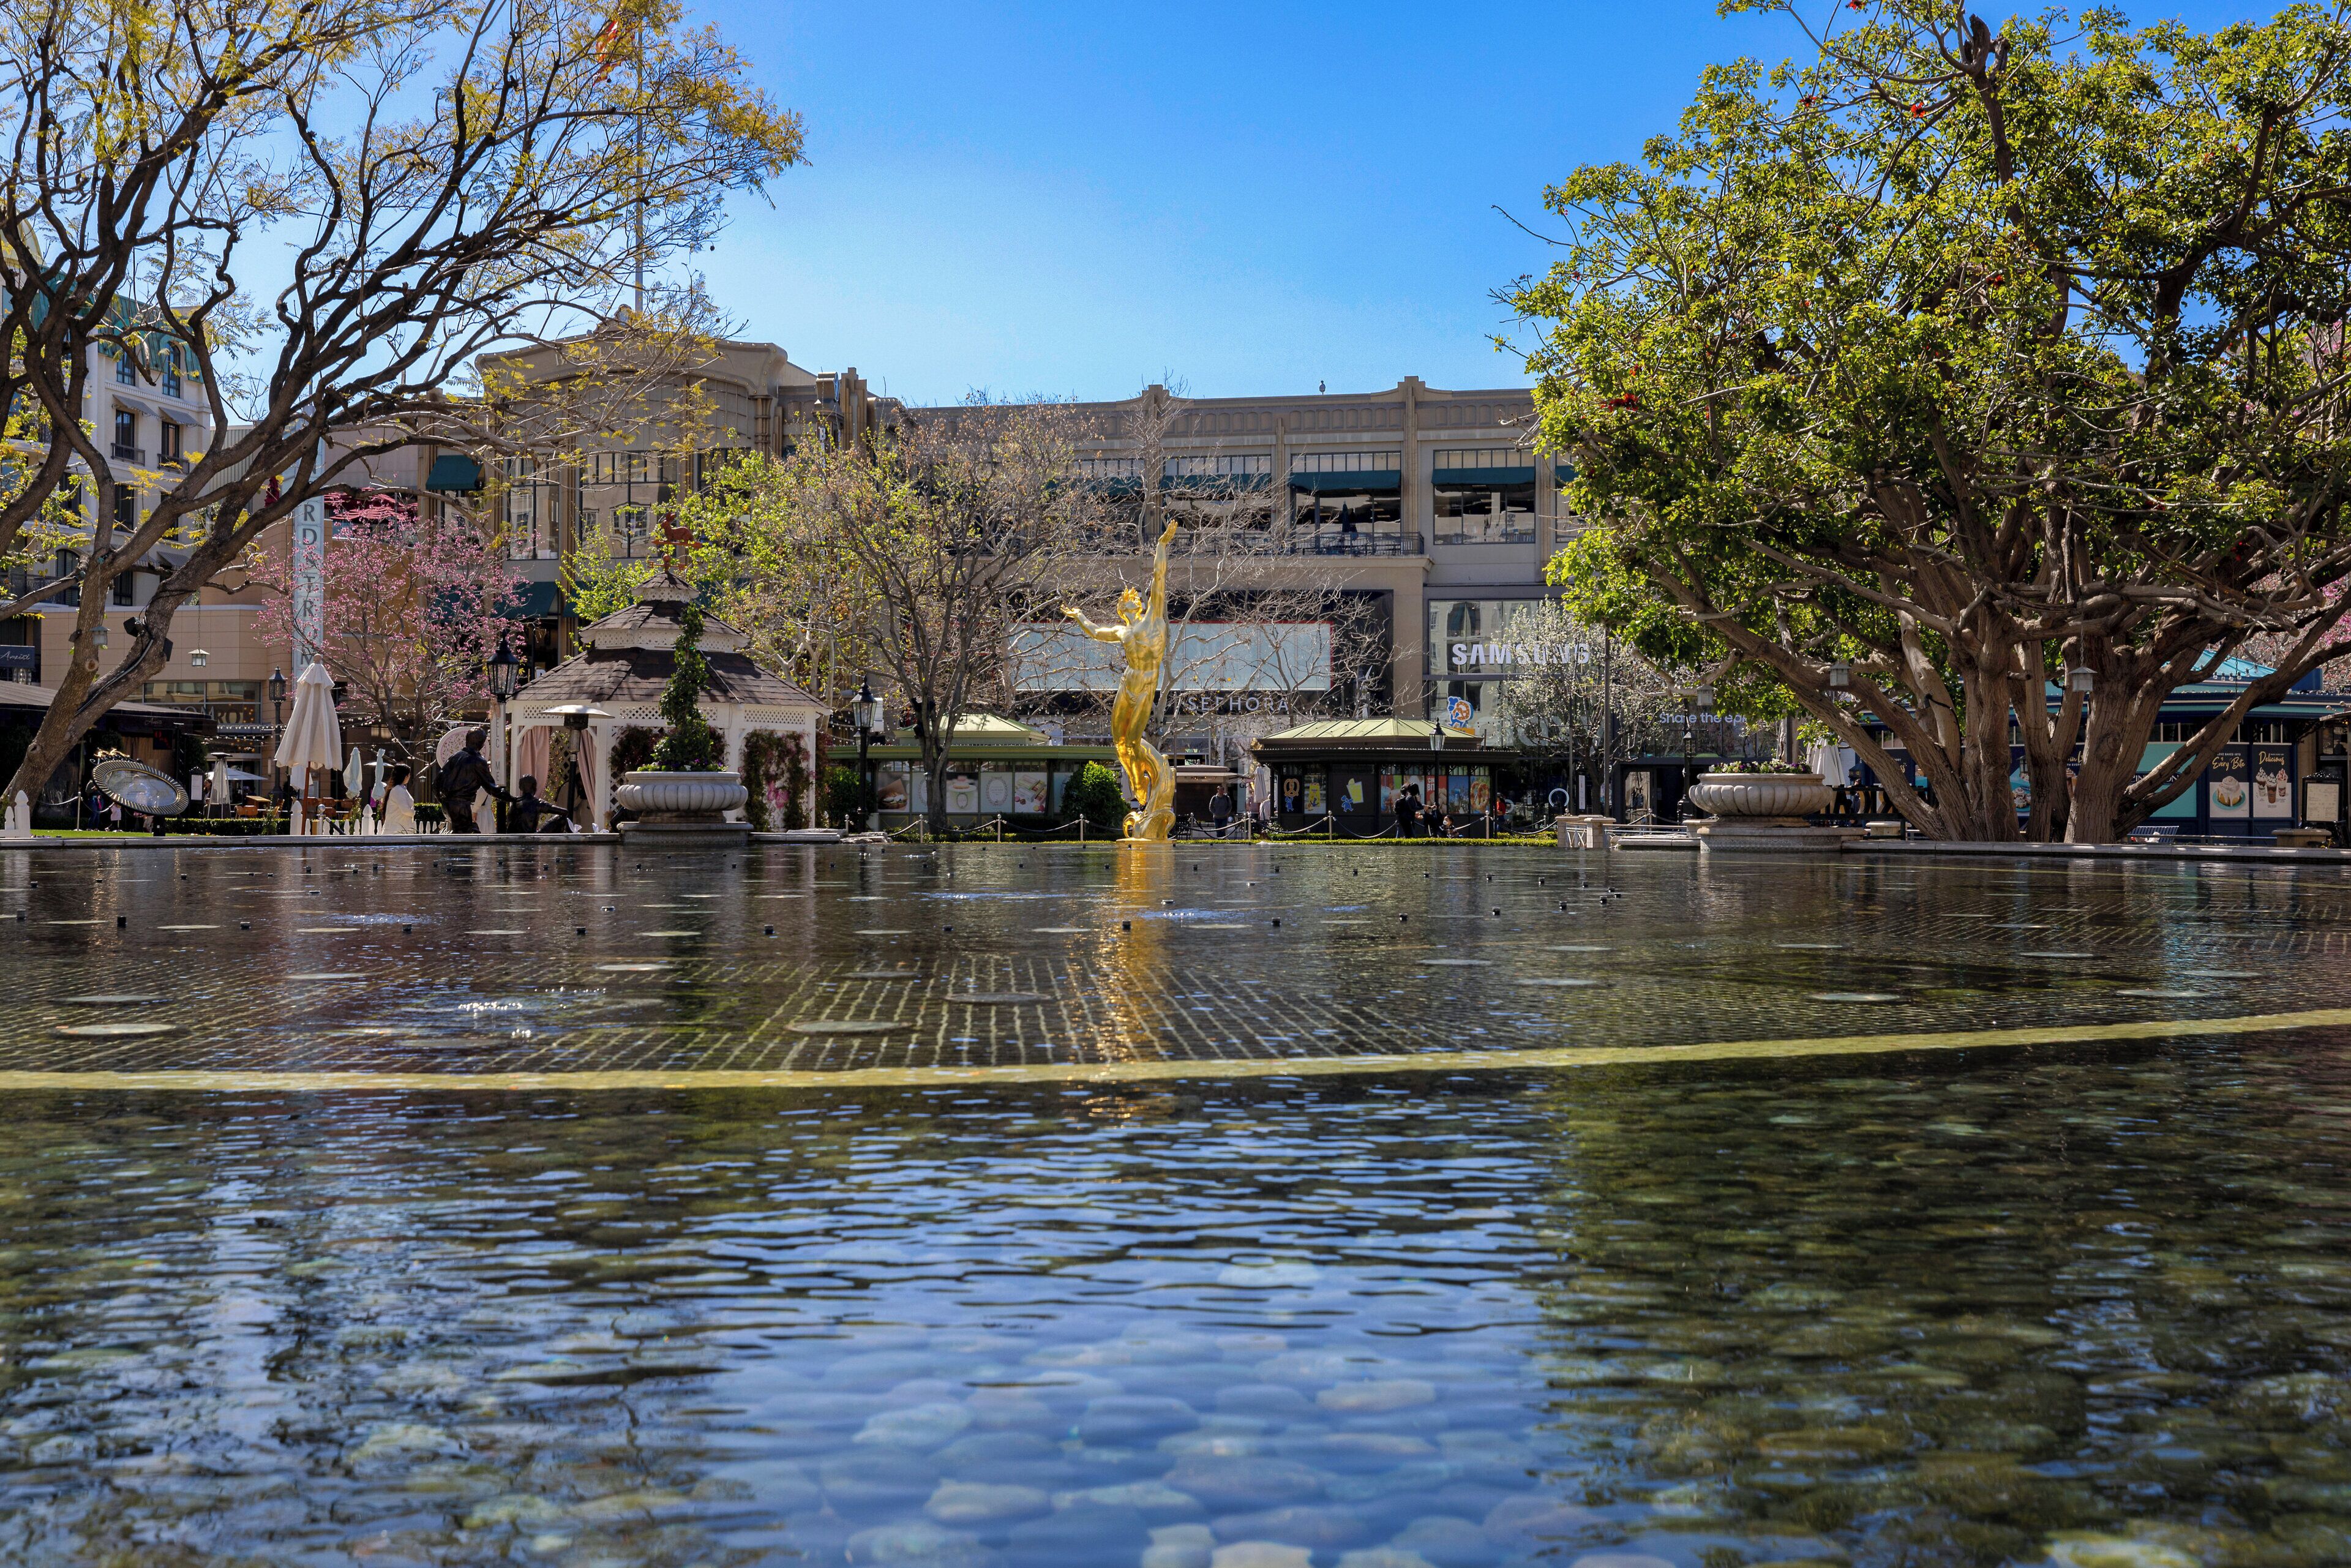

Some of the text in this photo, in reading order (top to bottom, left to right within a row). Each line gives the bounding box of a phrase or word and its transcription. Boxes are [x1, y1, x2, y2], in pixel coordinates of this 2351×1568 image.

[1452, 643, 1591, 665] SAMSUNG
[1188, 696, 1289, 711] SEPHORA
[1659, 711, 1697, 724] Shae
[1700, 712, 1722, 724] the
[2212, 756, 2246, 771] Every Bite
[2259, 751, 2285, 765] Delicious
